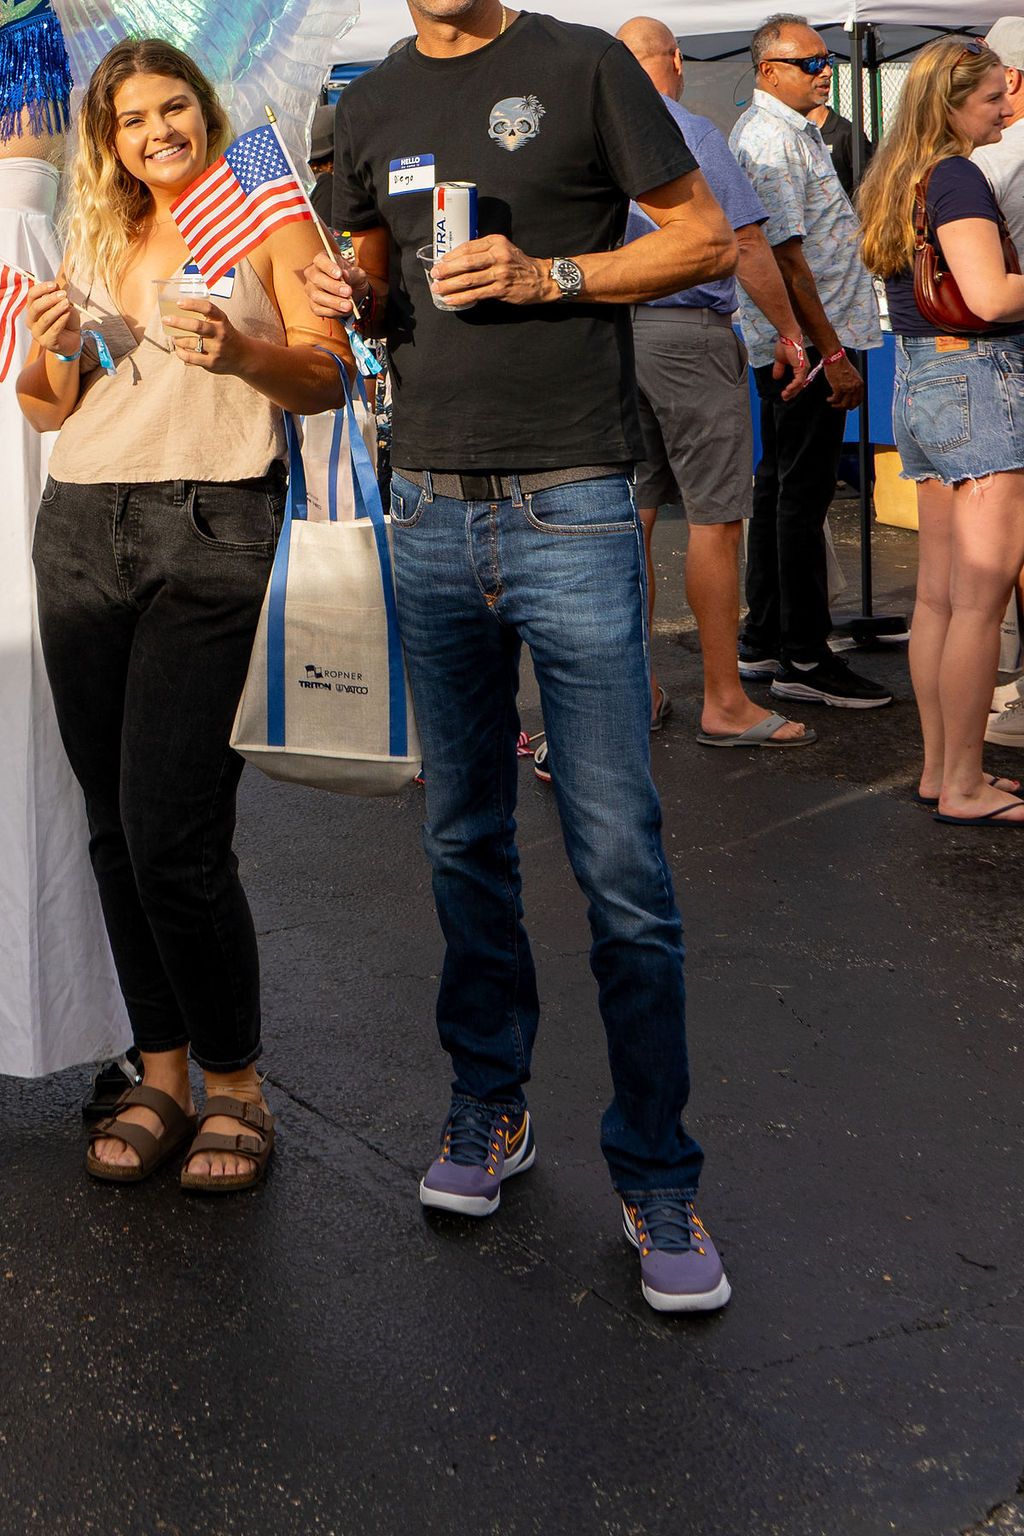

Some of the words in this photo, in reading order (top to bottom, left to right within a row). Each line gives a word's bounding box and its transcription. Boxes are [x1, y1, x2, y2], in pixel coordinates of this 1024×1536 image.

[400, 156, 421, 166] HELLO
[436, 219, 446, 257] TRA
[324, 670, 363, 681] ROPNER
[298, 680, 331, 691] TRITON
